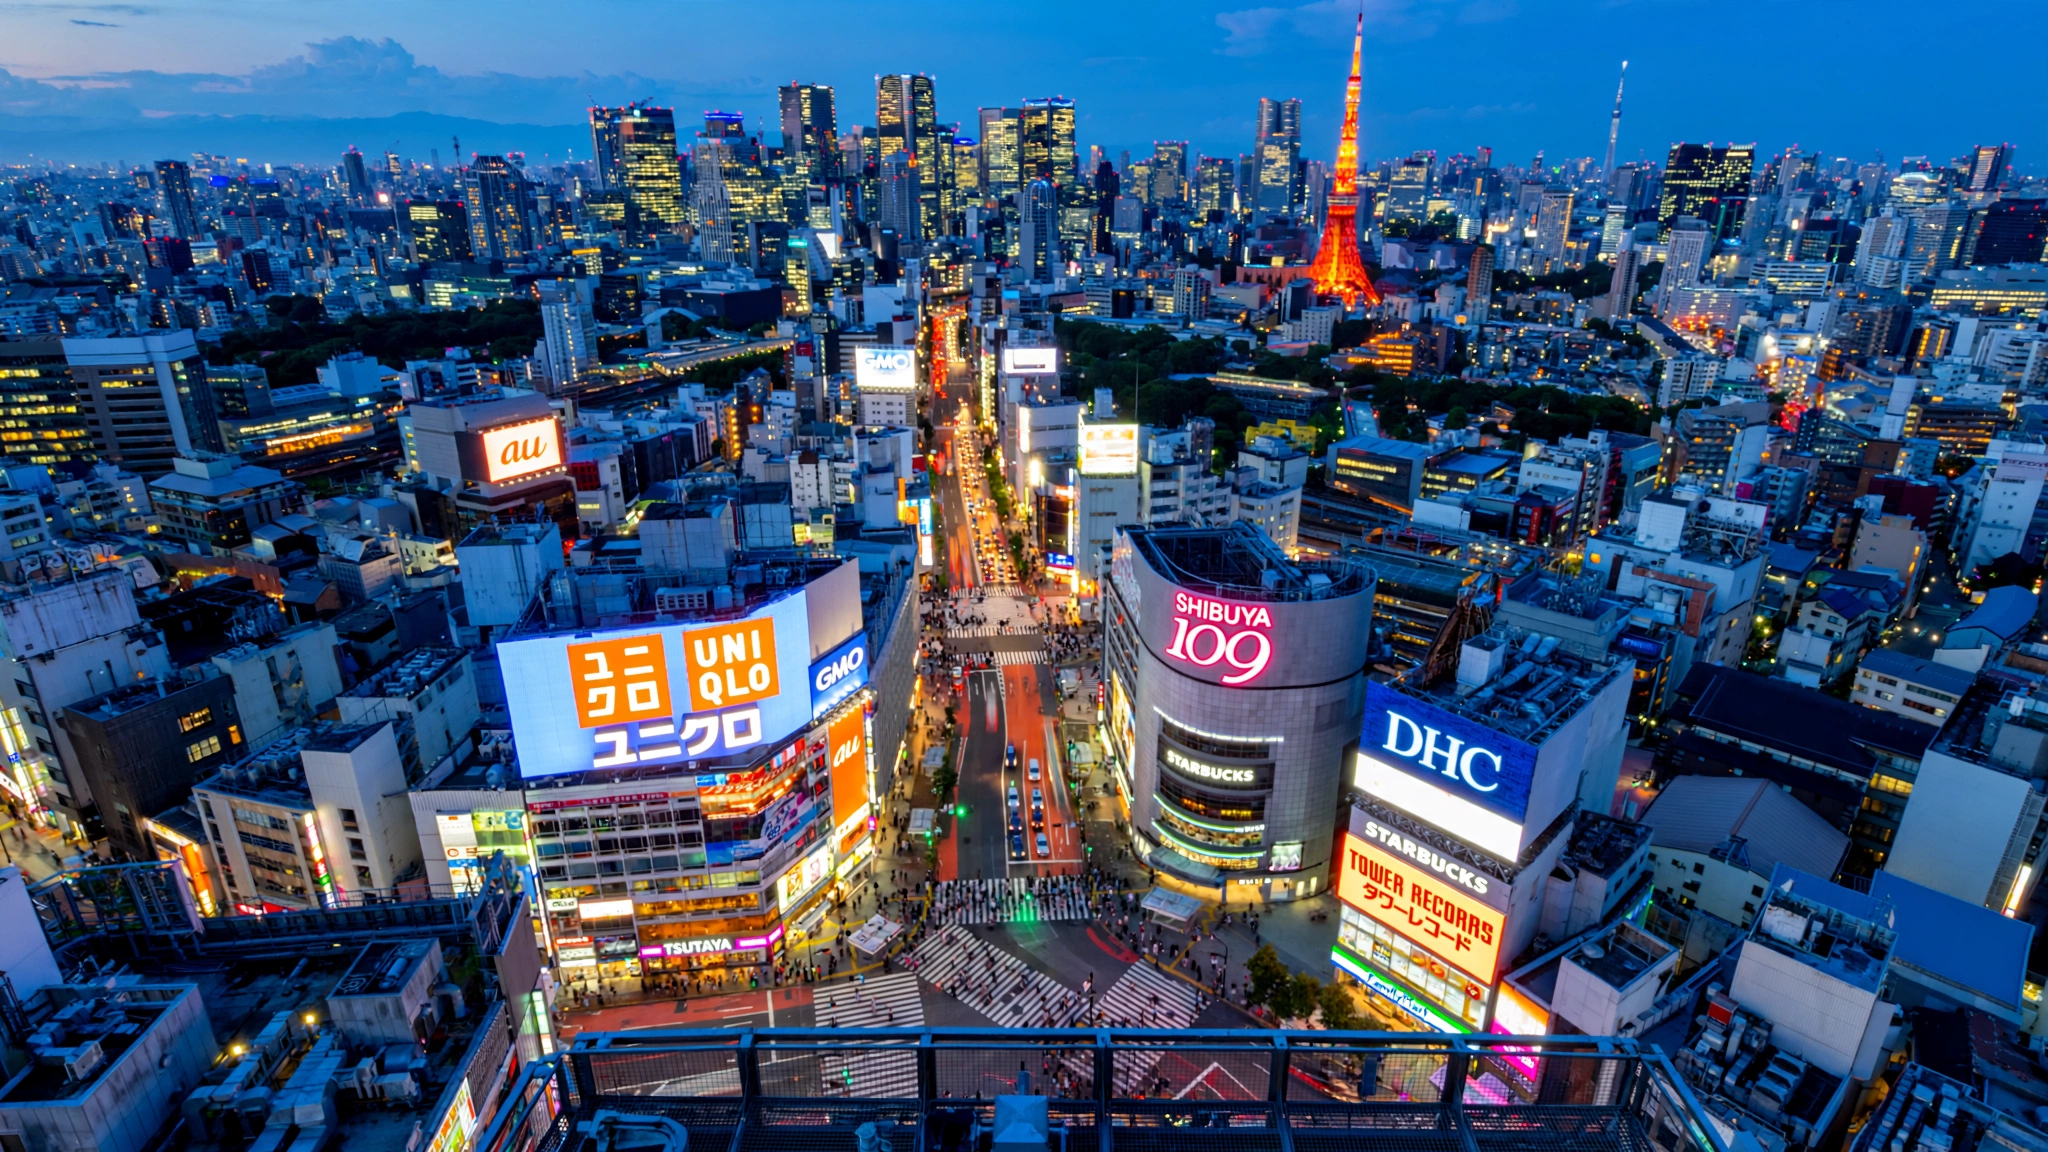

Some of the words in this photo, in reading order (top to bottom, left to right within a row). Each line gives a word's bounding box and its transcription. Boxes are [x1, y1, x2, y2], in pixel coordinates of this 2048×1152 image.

[501, 436, 547, 465] au
[1174, 592, 1272, 628] SHIBUYA
[694, 629, 762, 668] UNI
[815, 646, 864, 692] GMO
[1165, 616, 1272, 685] 109
[699, 662, 771, 706] QLO
[593, 708, 763, 768] ユニクロ
[833, 734, 861, 768] au
[1382, 710, 1502, 793] DHC
[1166, 750, 1254, 782] STARBUCKS
[1349, 848, 1404, 898] TOWER
[1364, 821, 1488, 895] STARBUCKS
[1363, 882, 1472, 952] タワーレコード
[663, 938, 733, 956] TSUTAYA
